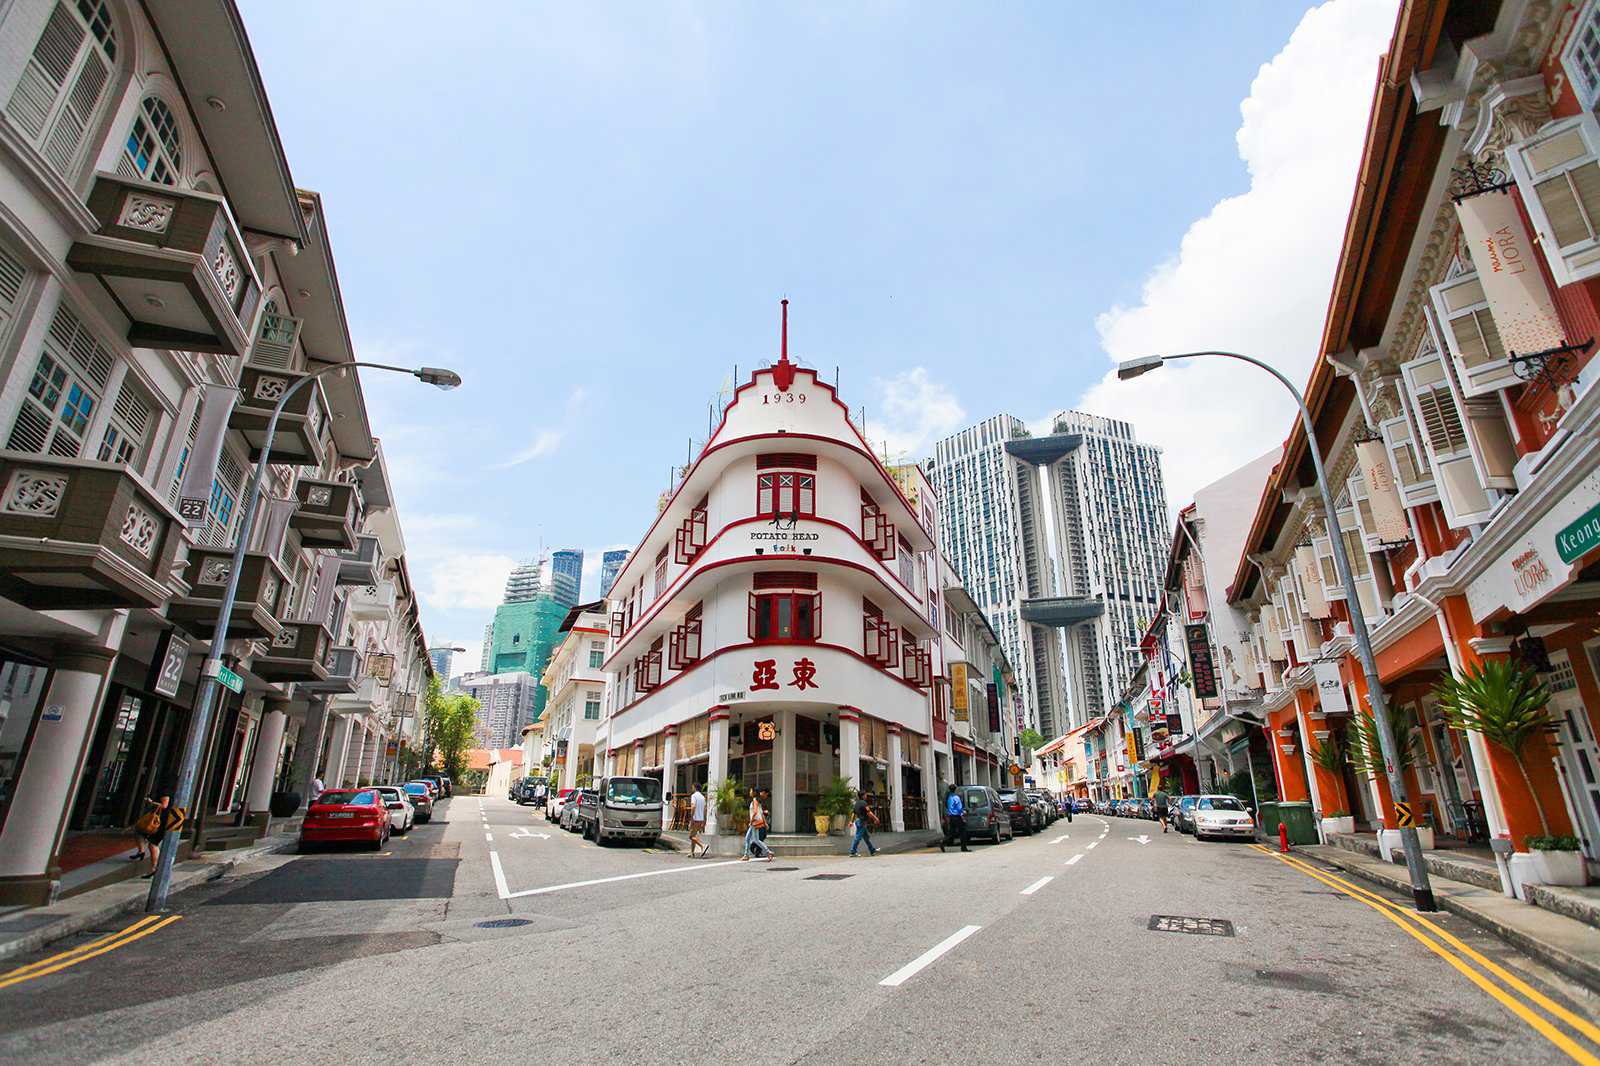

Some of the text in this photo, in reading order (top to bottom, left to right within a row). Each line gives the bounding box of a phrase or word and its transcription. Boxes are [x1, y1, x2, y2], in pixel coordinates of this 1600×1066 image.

[1496, 226, 1526, 275] LIORA
[762, 391, 806, 404] 1939
[182, 504, 201, 515] 22
[750, 532, 819, 541] POTATO HEAD
[773, 544, 796, 552] Folk
[1514, 559, 1549, 596] LIORA
[164, 654, 182, 680] 22
[750, 657, 819, 691] 亞東
